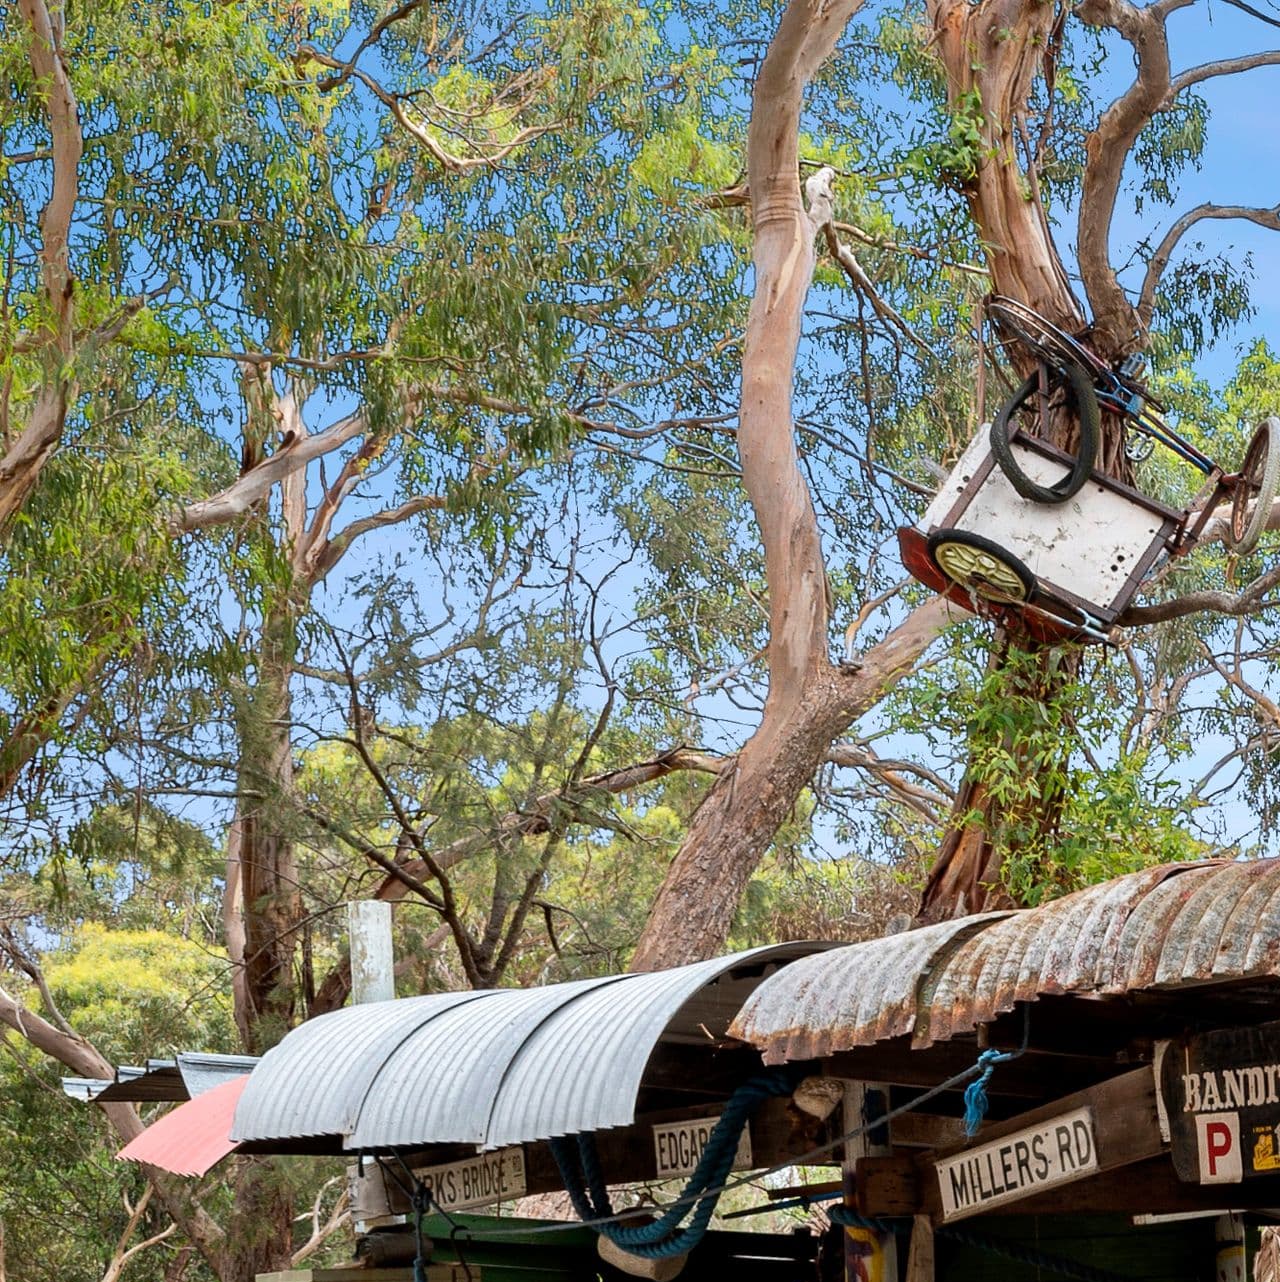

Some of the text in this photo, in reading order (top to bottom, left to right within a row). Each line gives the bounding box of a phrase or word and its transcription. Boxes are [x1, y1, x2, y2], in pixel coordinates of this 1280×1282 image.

[658, 1126, 716, 1170] EDGAR
[949, 1119, 1092, 1209] MILLERS RD
[1206, 1122, 1232, 1176] P
[422, 1170, 457, 1204] RKS
[462, 1158, 508, 1200] BRIDGE
